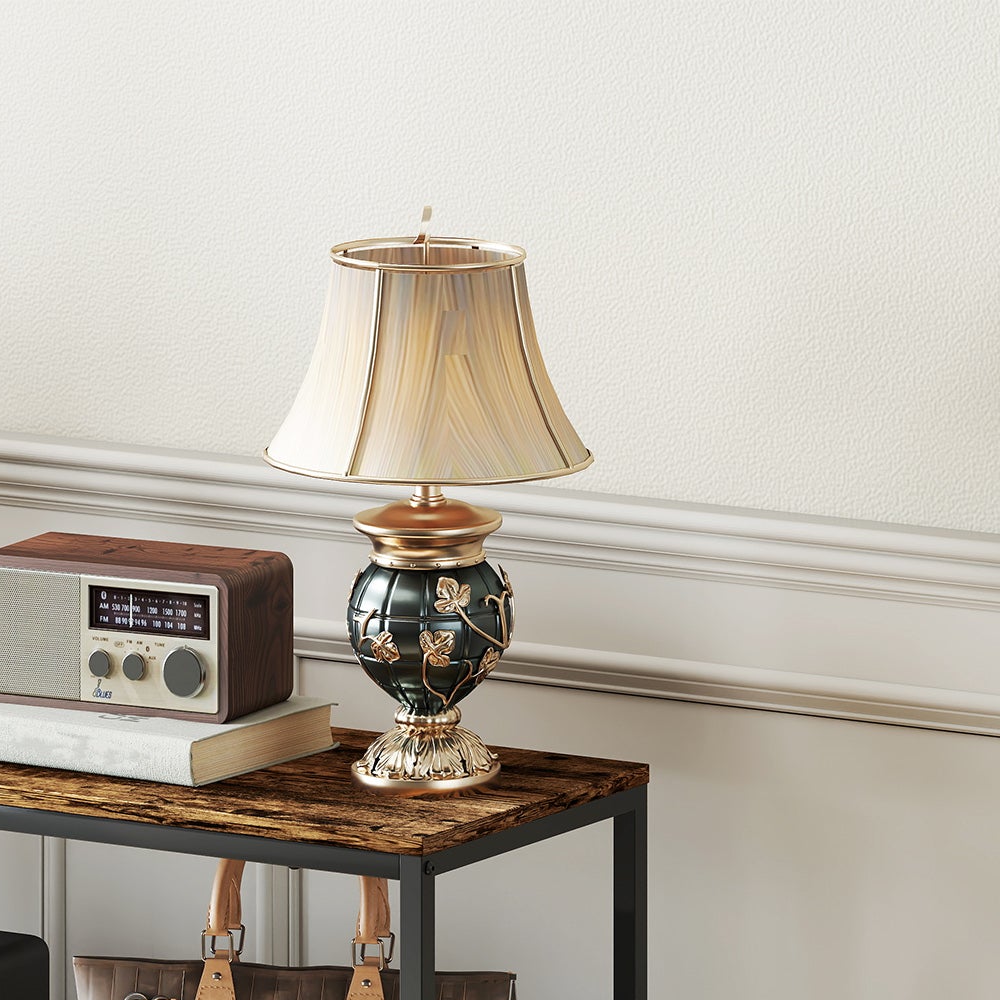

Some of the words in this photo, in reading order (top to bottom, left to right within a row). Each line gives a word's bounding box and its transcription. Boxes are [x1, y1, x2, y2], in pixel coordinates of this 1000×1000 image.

[163, 608, 173, 616] 1500
[176, 609, 187, 617] 1700
[153, 620, 161, 628] 100
